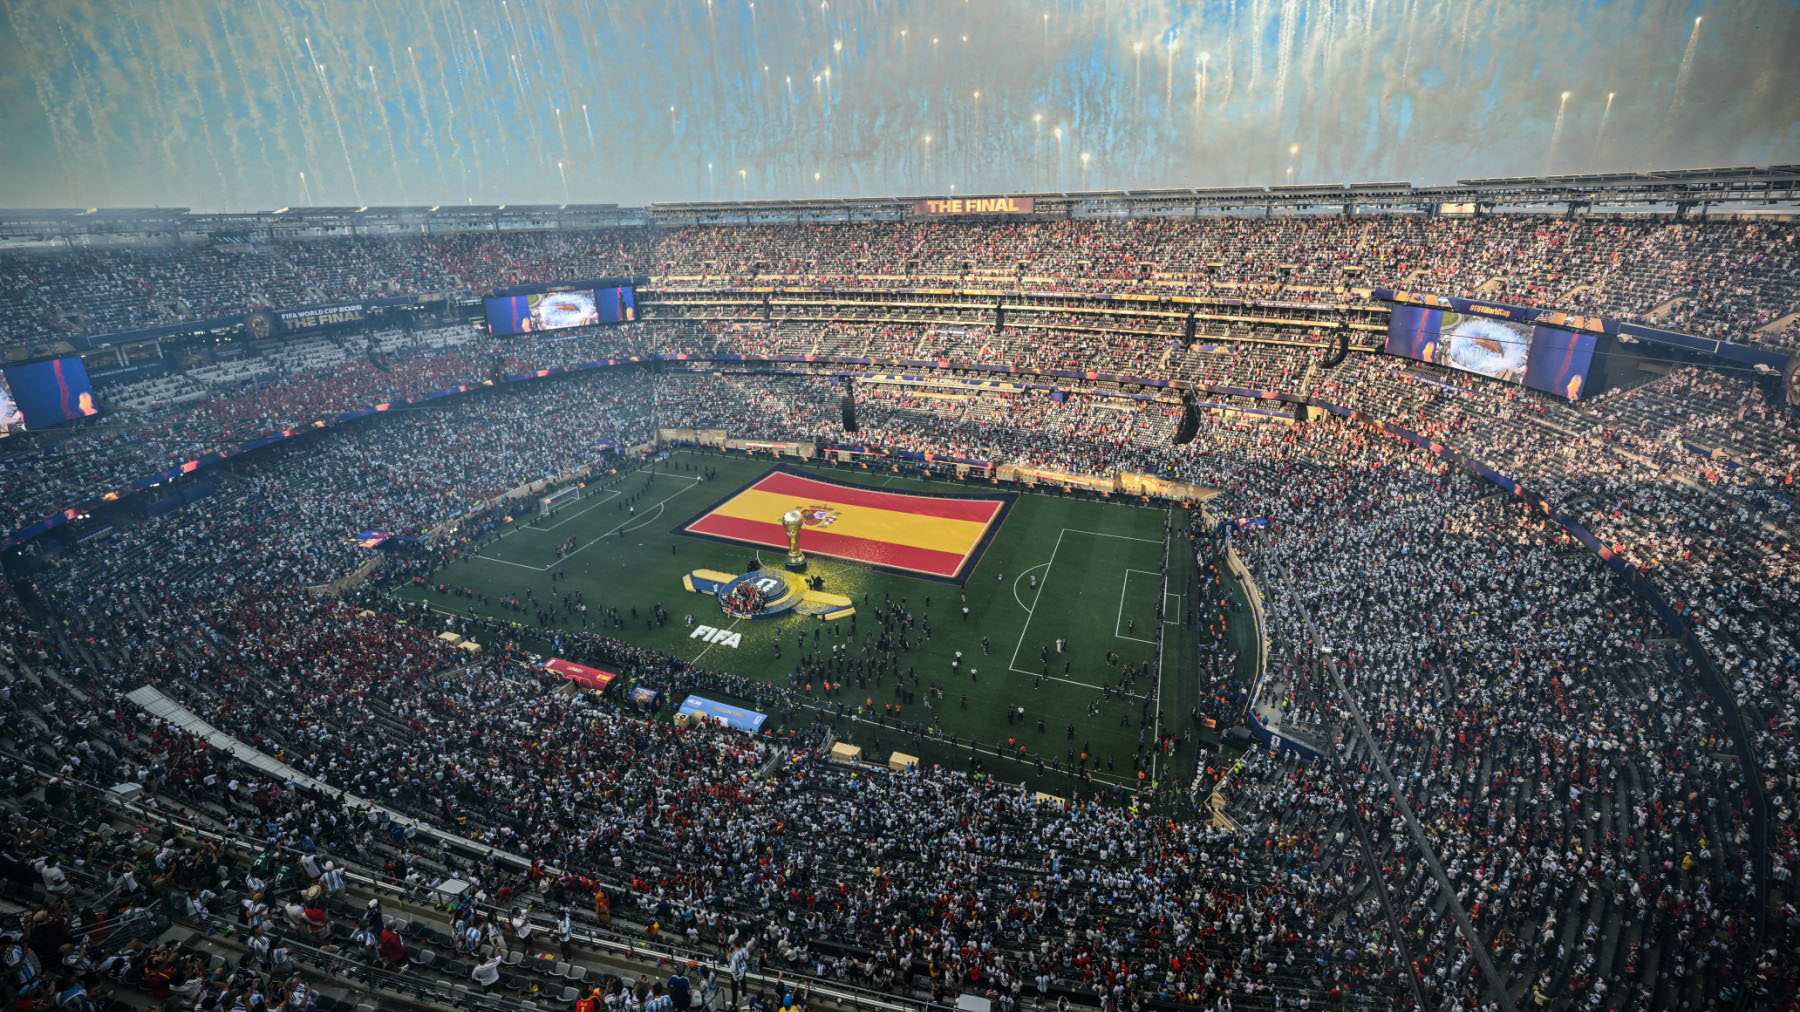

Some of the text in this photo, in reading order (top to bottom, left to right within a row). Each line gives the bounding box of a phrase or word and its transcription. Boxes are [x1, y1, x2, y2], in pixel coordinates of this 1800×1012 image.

[927, 198, 1020, 213] THE FINAL
[298, 309, 324, 318] WORLD
[324, 307, 338, 315] CUP
[338, 304, 363, 313] 2026
[285, 311, 364, 329] THE FINAL
[689, 624, 742, 649] FIFA
